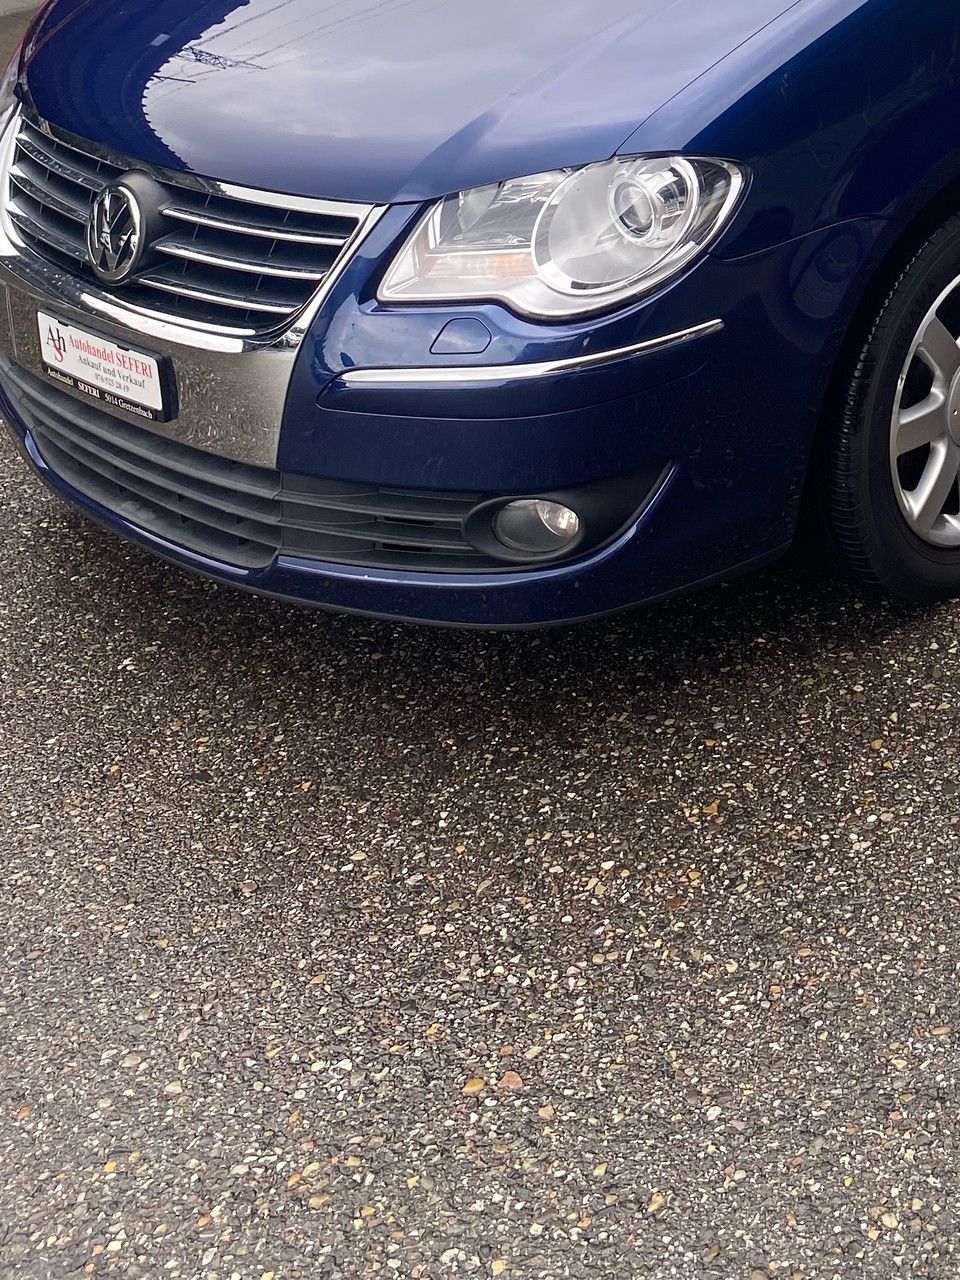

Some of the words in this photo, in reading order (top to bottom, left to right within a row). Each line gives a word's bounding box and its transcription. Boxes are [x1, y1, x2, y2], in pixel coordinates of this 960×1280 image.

[69, 334, 114, 365] Autohandel
[116, 352, 153, 379] SEFERI
[78, 355, 102, 372] Ankauf
[103, 366, 116, 378] und
[117, 370, 145, 389] Verkauf
[77, 381, 100, 399] SEFERI
